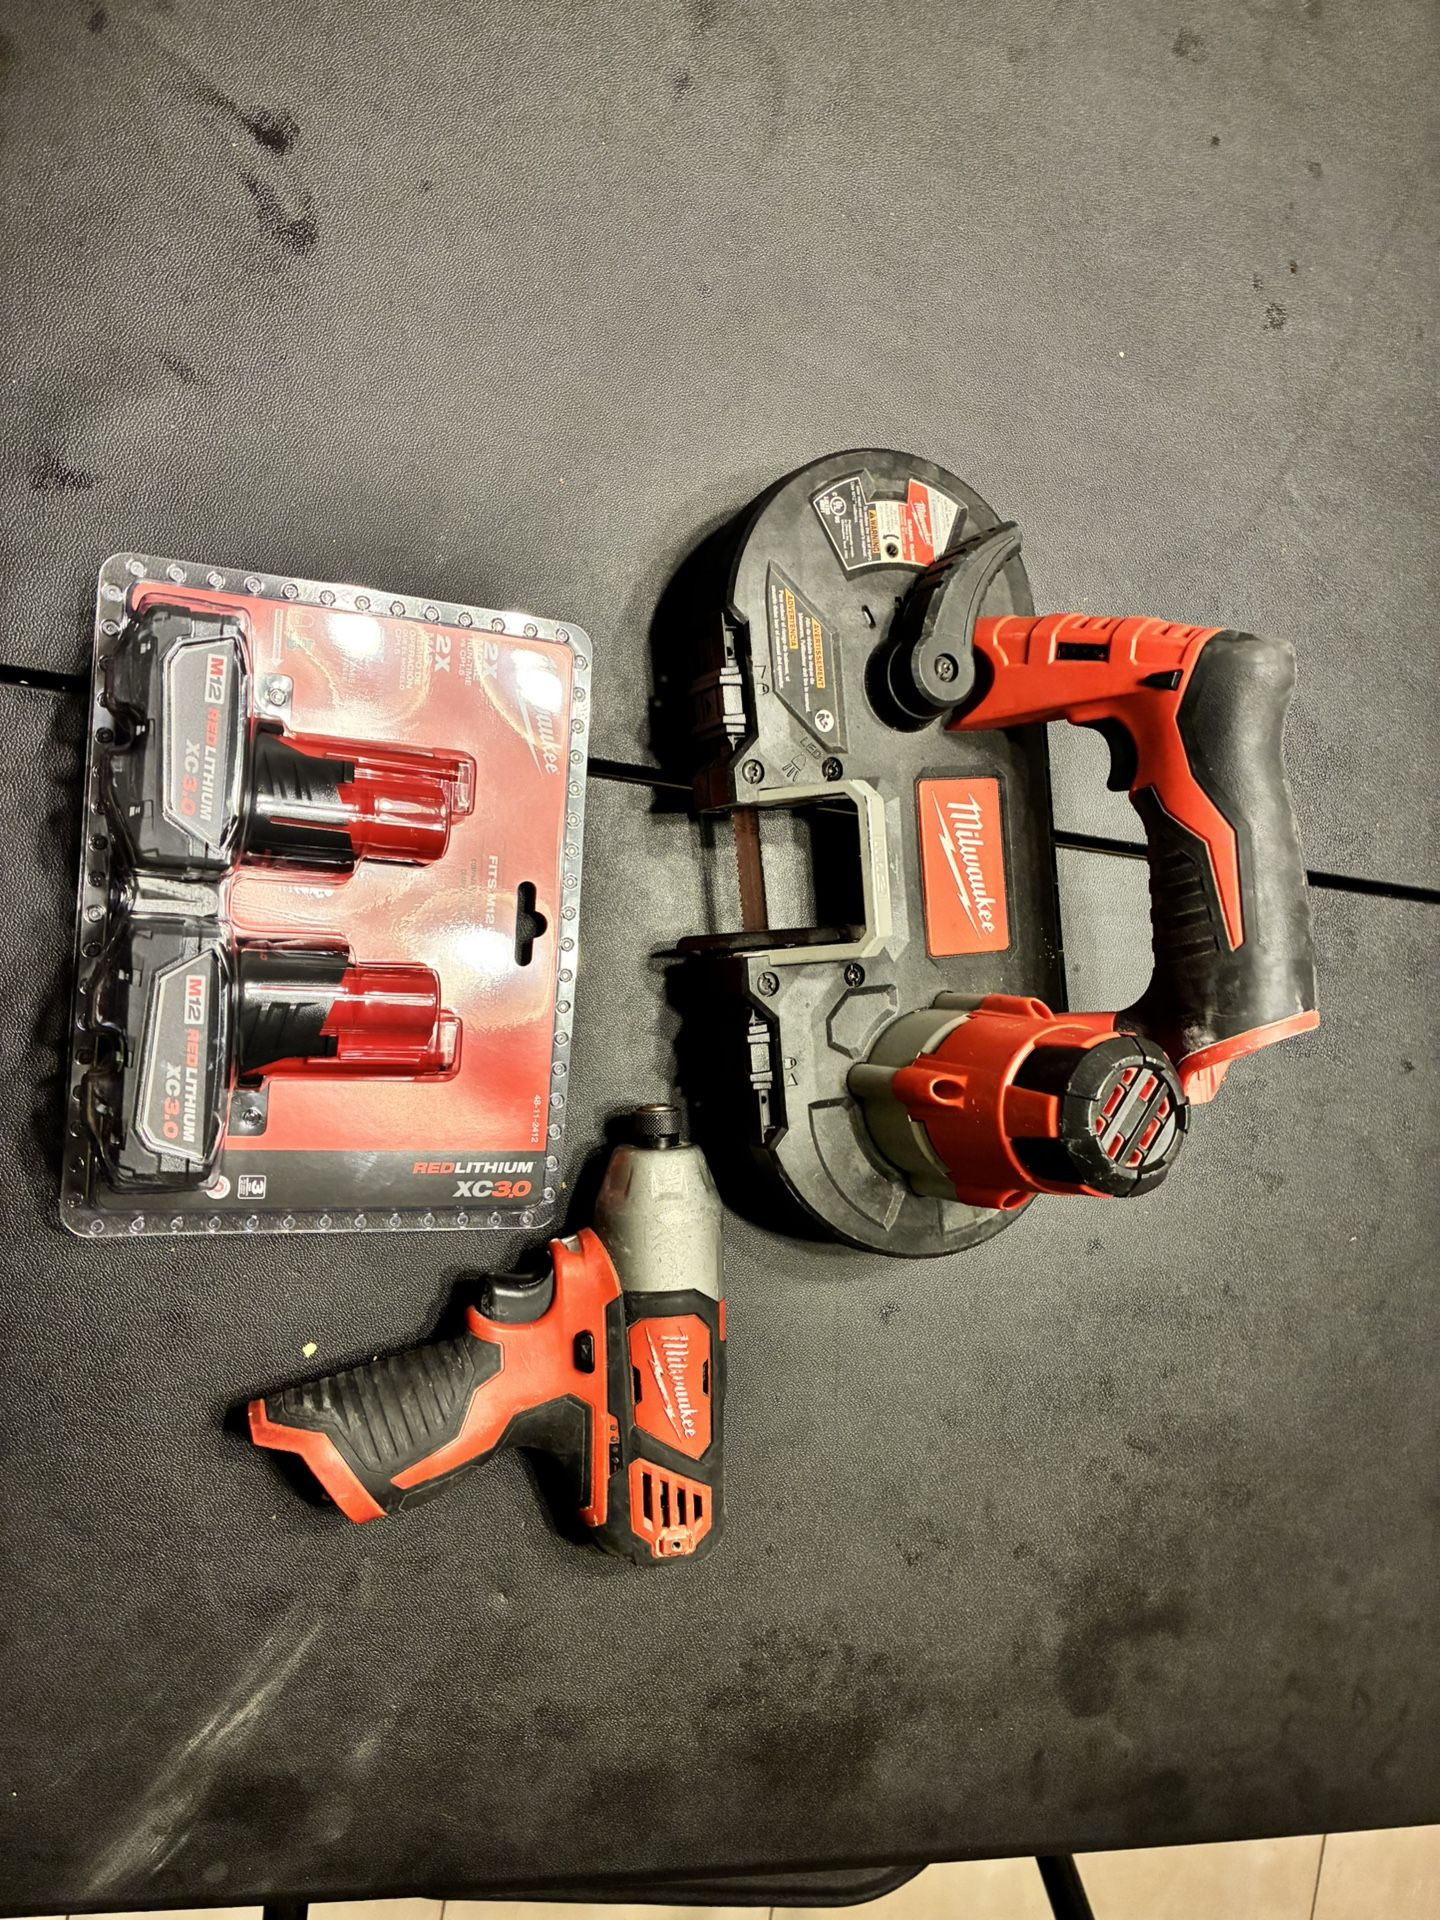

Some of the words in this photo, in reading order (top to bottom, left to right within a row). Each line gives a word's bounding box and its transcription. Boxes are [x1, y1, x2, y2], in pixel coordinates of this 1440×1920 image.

[870, 520, 880, 552] WARNING
[787, 595, 798, 647] ADVERTENCIA
[434, 633, 451, 673] 2X
[485, 643, 499, 681] 2X
[812, 624, 824, 687] AVERTISSEMENT
[208, 656, 225, 702] M12
[200, 705, 221, 820] REDLITHIUM
[799, 736, 822, 760] LED
[180, 737, 201, 816] XC3.0
[486, 854, 499, 888] FITS
[946, 792, 997, 936] Milwaukee
[187, 977, 203, 1023] M12
[162, 1061, 182, 1139] XC3.0
[182, 1027, 201, 1143] REDLITHIUM
[529, 1093, 542, 1144] 48-11-2412
[250, 1180, 264, 1195] 3
[412, 1161, 534, 1174] REDLITHIUM
[452, 1180, 532, 1199] XC3.0
[659, 1325, 699, 1440] Milwaukee
